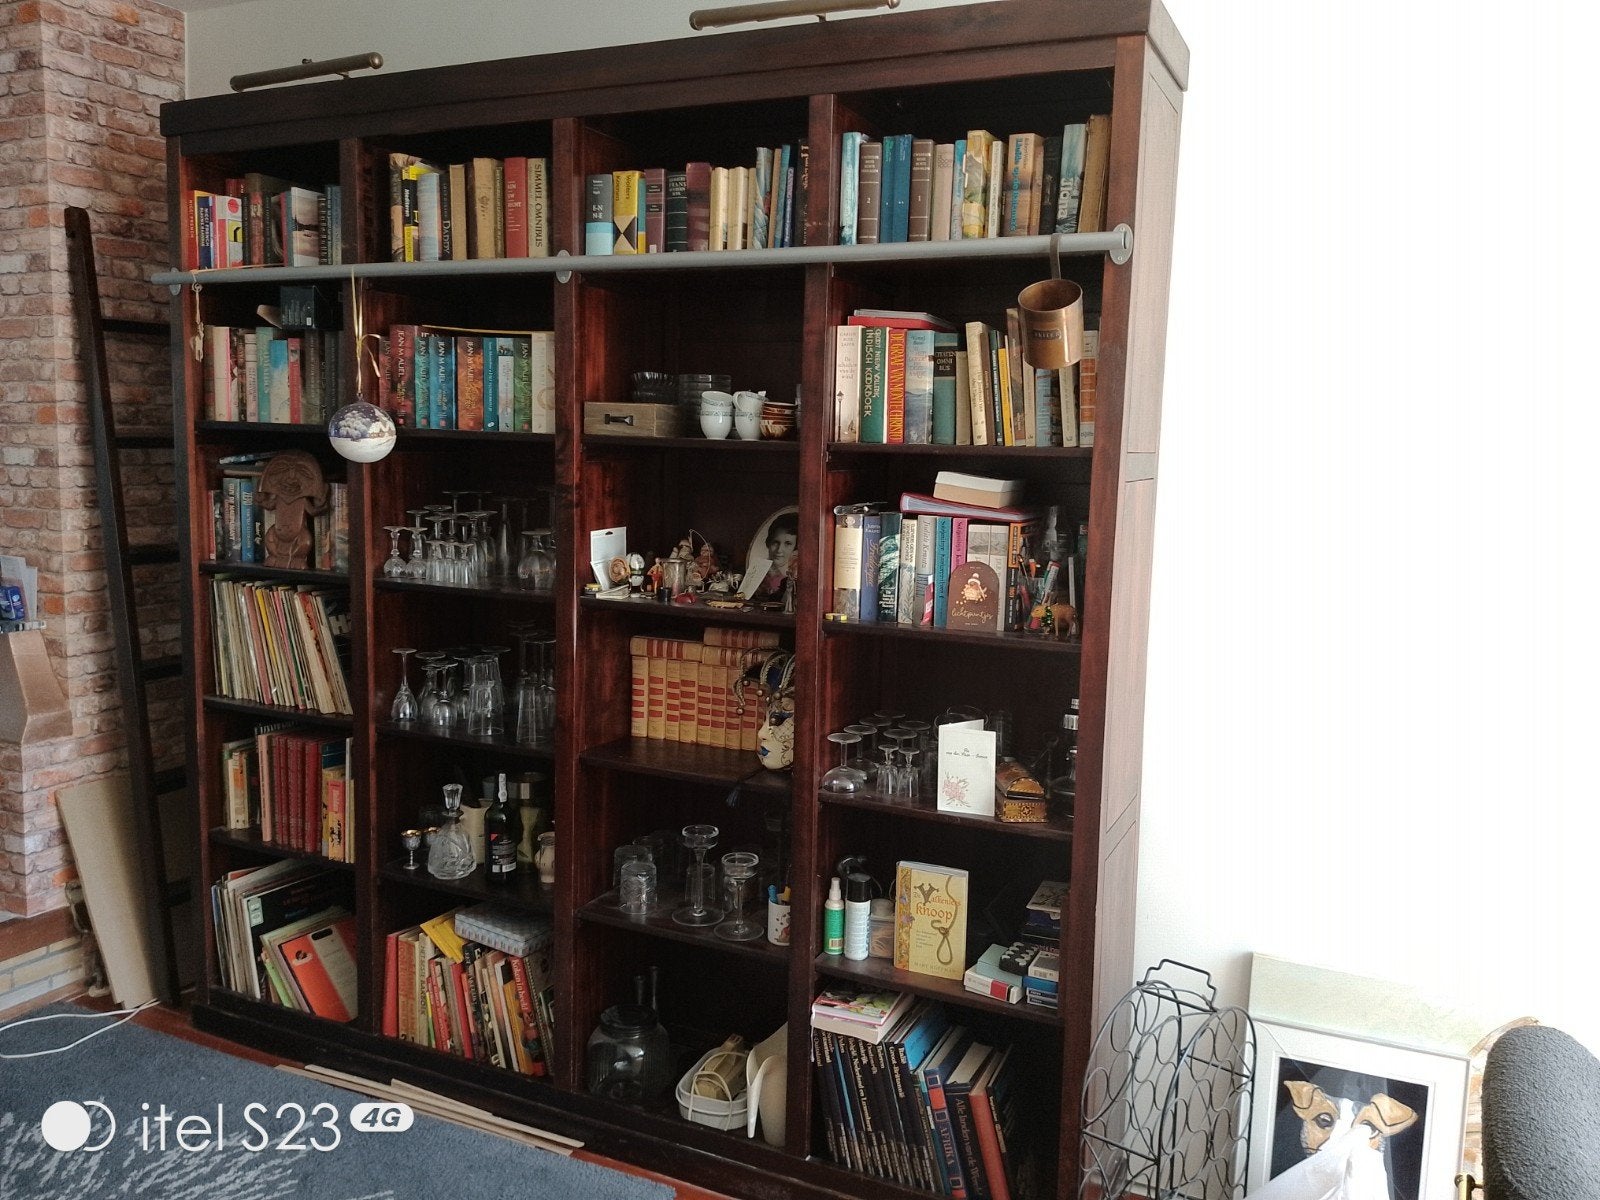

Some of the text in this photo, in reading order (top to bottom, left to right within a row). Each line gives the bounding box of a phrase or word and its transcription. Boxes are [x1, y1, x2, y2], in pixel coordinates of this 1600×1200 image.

[534, 163, 543, 248] SIMMEL OMNIBUS
[443, 220, 451, 254] DADDY
[397, 330, 405, 347] JEAN
[521, 343, 529, 358] JEAN
[863, 329, 874, 418] INDISCH KOOKBOEK
[874, 350, 882, 371] NIEUW
[889, 333, 904, 440] DE GRAAF VAN MONTE CHRISTO
[921, 520, 931, 569] Judith Krantz
[916, 902, 953, 922] knoop
[512, 959, 521, 982] Koken
[518, 990, 529, 1011] beeld
[822, 1031, 832, 1063] witserland
[853, 1058, 865, 1089] Nederland
[940, 1126, 954, 1165] AFRIKA
